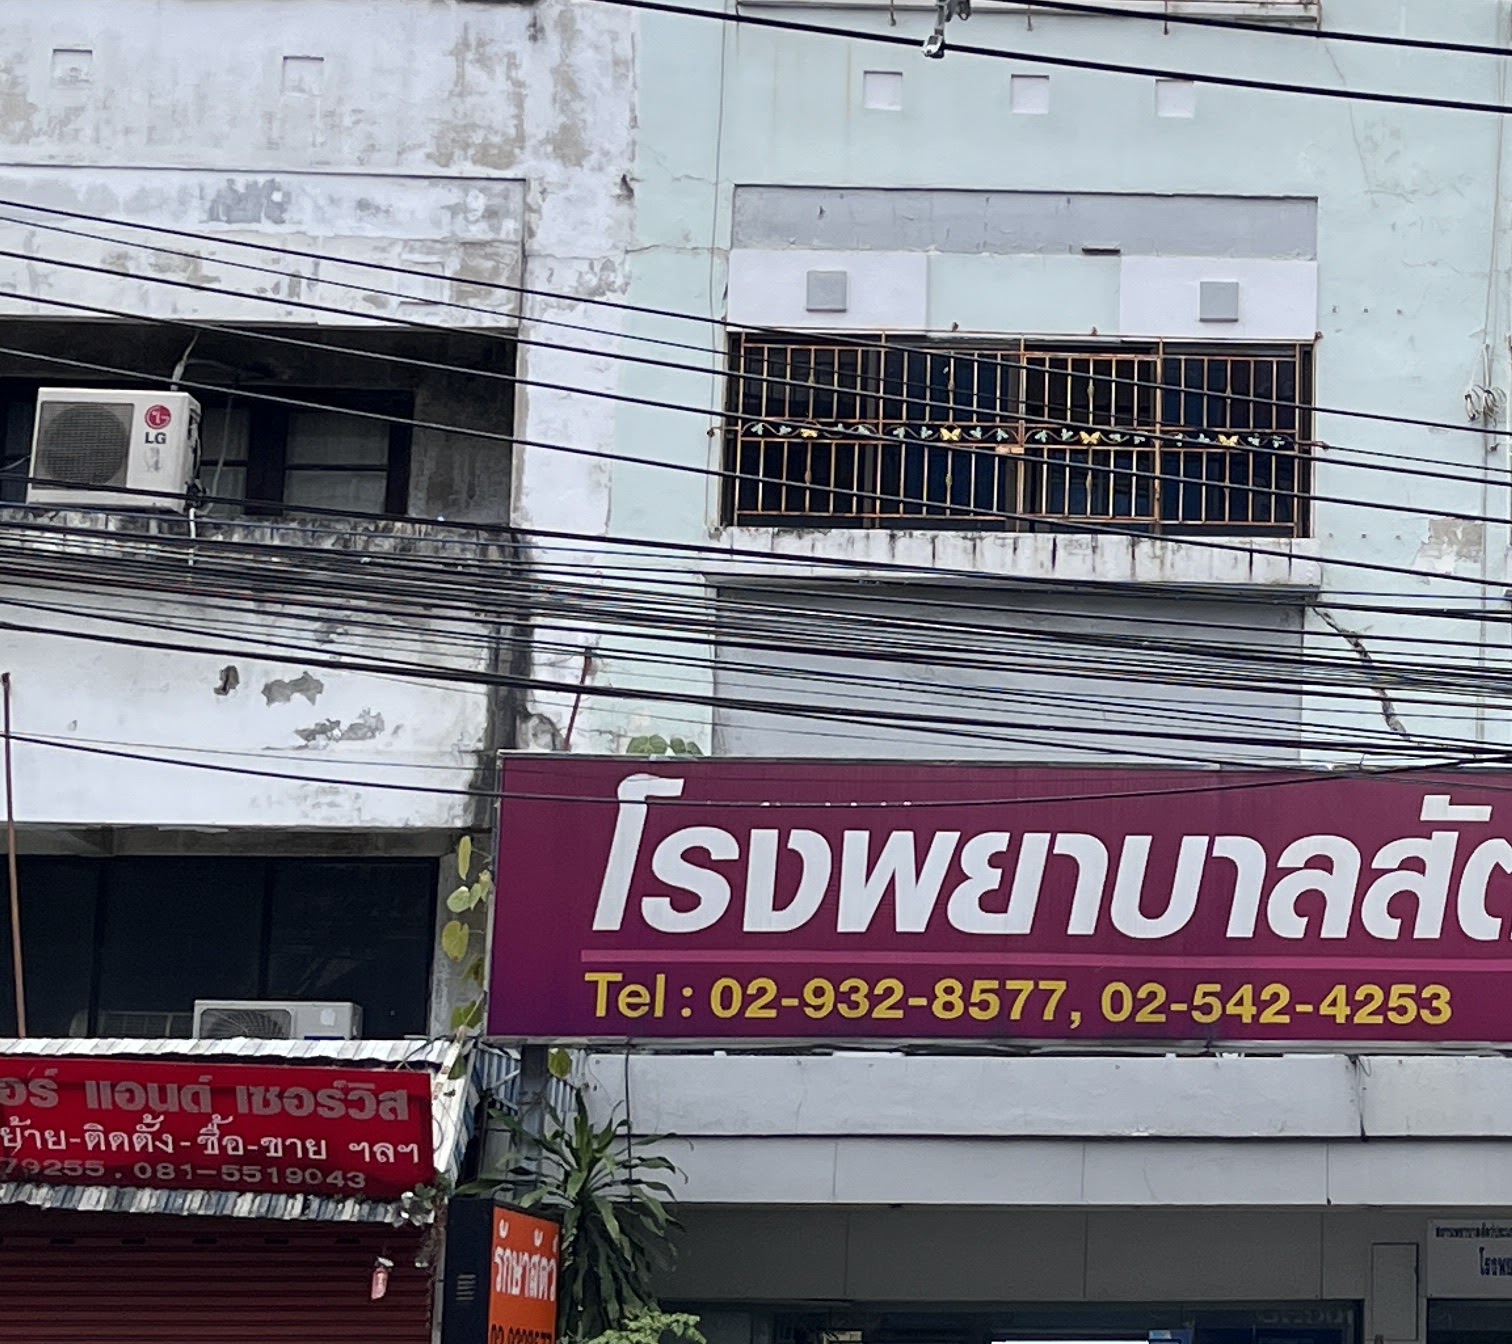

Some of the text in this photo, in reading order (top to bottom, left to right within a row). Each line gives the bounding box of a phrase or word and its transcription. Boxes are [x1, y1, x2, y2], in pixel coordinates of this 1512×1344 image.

[144, 431, 167, 445] LG
[586, 972, 665, 1017] Tel
[710, 978, 1081, 1025] 02-932-8577,
[1101, 982, 1451, 1024] 02-542-4253
[85, 1075, 213, 1114] แอนด์
[348, 1141, 419, 1164] ฯลฯ
[133, 1161, 366, 1189] 081-5519043
[494, 1218, 560, 1302] รักษาสัตว์
